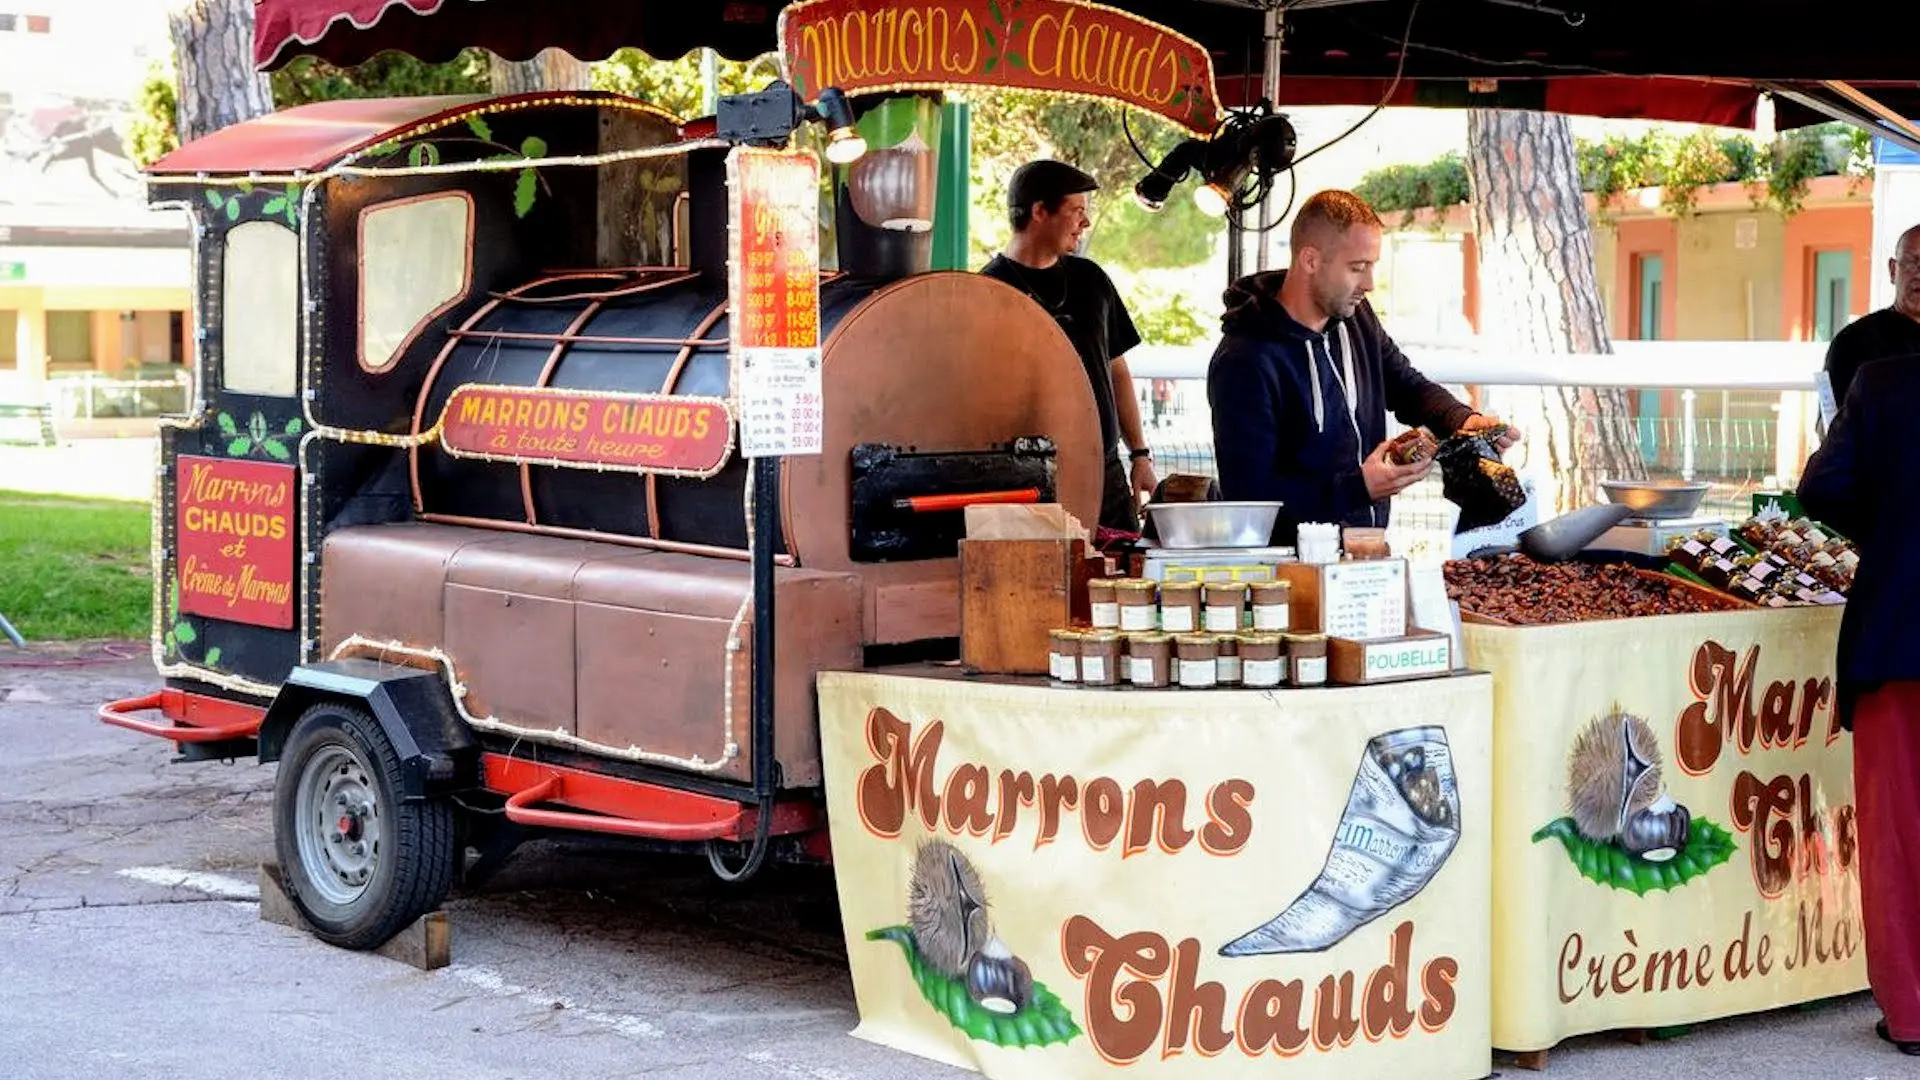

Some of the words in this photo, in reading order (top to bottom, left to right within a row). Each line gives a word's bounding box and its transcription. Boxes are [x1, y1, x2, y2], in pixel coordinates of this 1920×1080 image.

[1027, 6, 1180, 105] chauds
[459, 395, 589, 432] MARRONS
[602, 402, 712, 440] CHAUDS
[517, 432, 578, 453] toute
[585, 434, 667, 459] heure
[181, 462, 286, 508] Marrons
[185, 506, 287, 540] CHAUDS
[219, 537, 248, 558] et
[227, 564, 291, 607] Marrons
[1367, 647, 1447, 669] POUBELLE
[856, 705, 1257, 860] Marrons
[1557, 929, 1713, 1004] Crème
[1723, 909, 1774, 985] de
[1784, 896, 1862, 971] Ma
[1061, 914, 1460, 1066] Chauds
